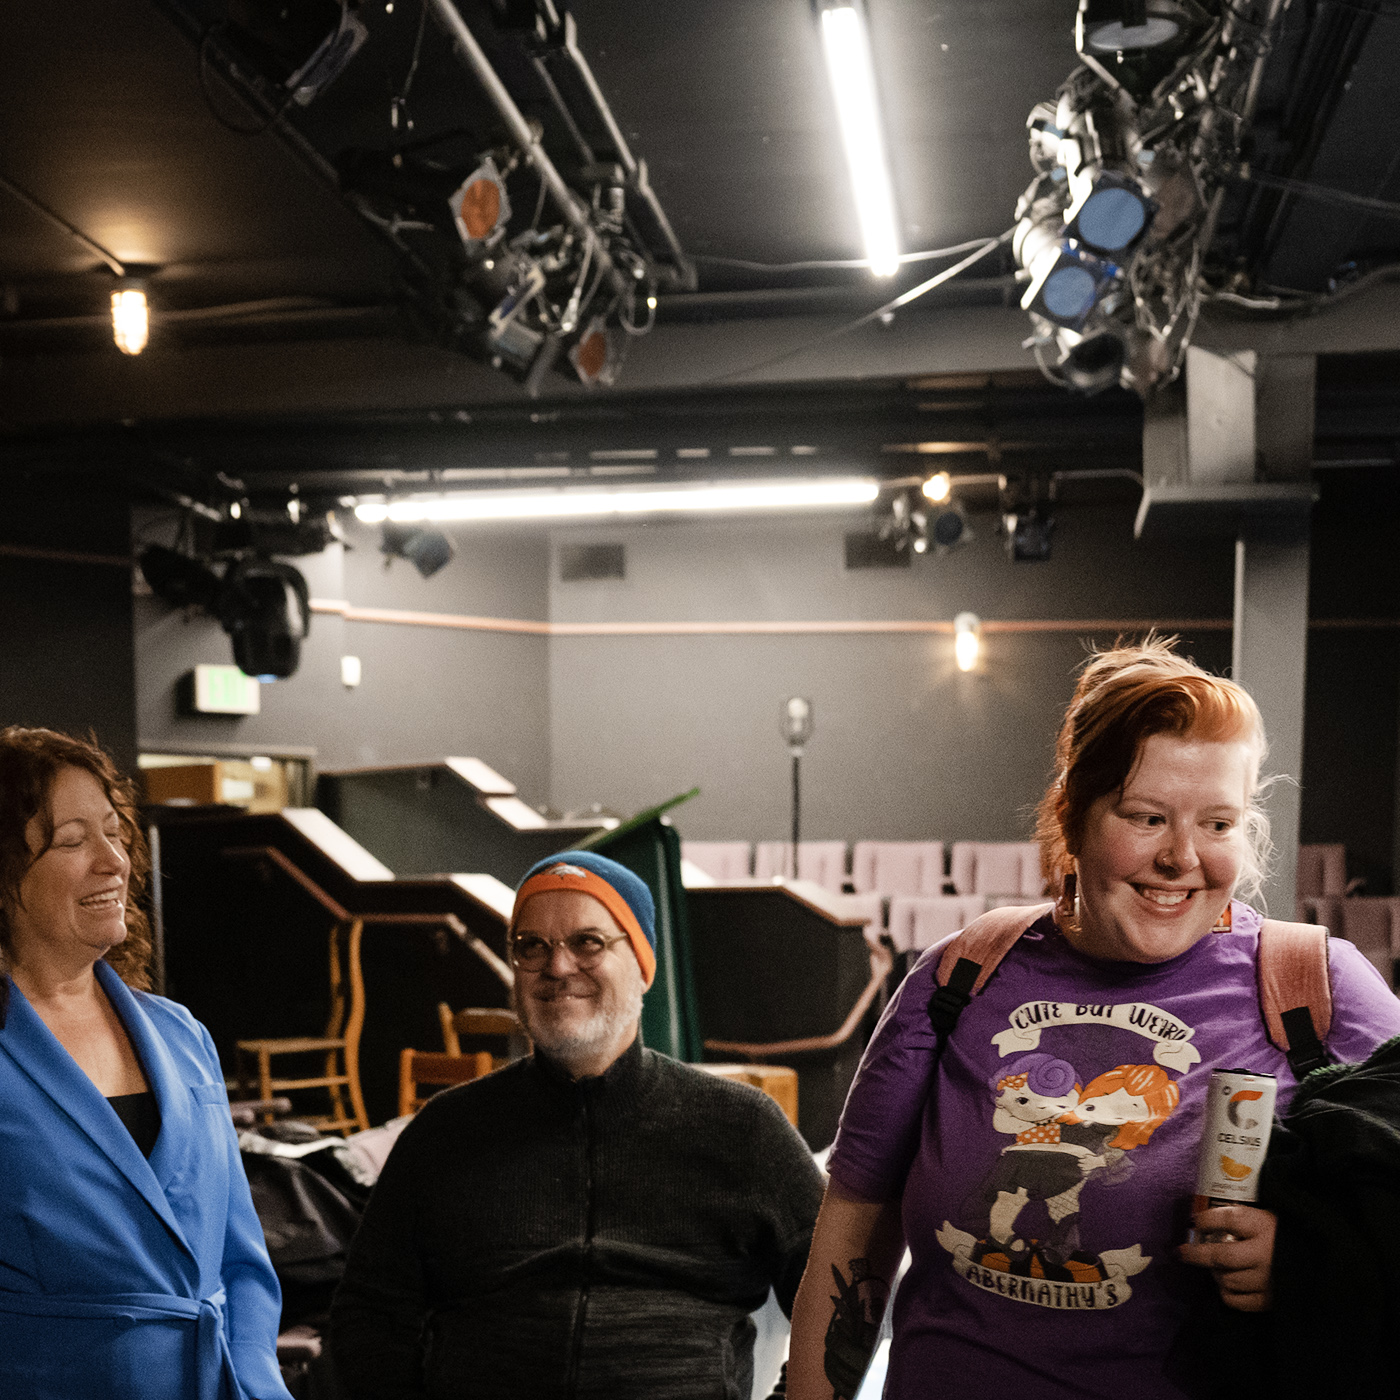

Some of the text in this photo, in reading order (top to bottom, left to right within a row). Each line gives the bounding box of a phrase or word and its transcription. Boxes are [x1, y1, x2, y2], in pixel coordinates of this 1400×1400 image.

[1015, 1003, 1188, 1041] CUTE BUT WEIRD
[966, 1266, 1118, 1308] ABERNATHY'S
